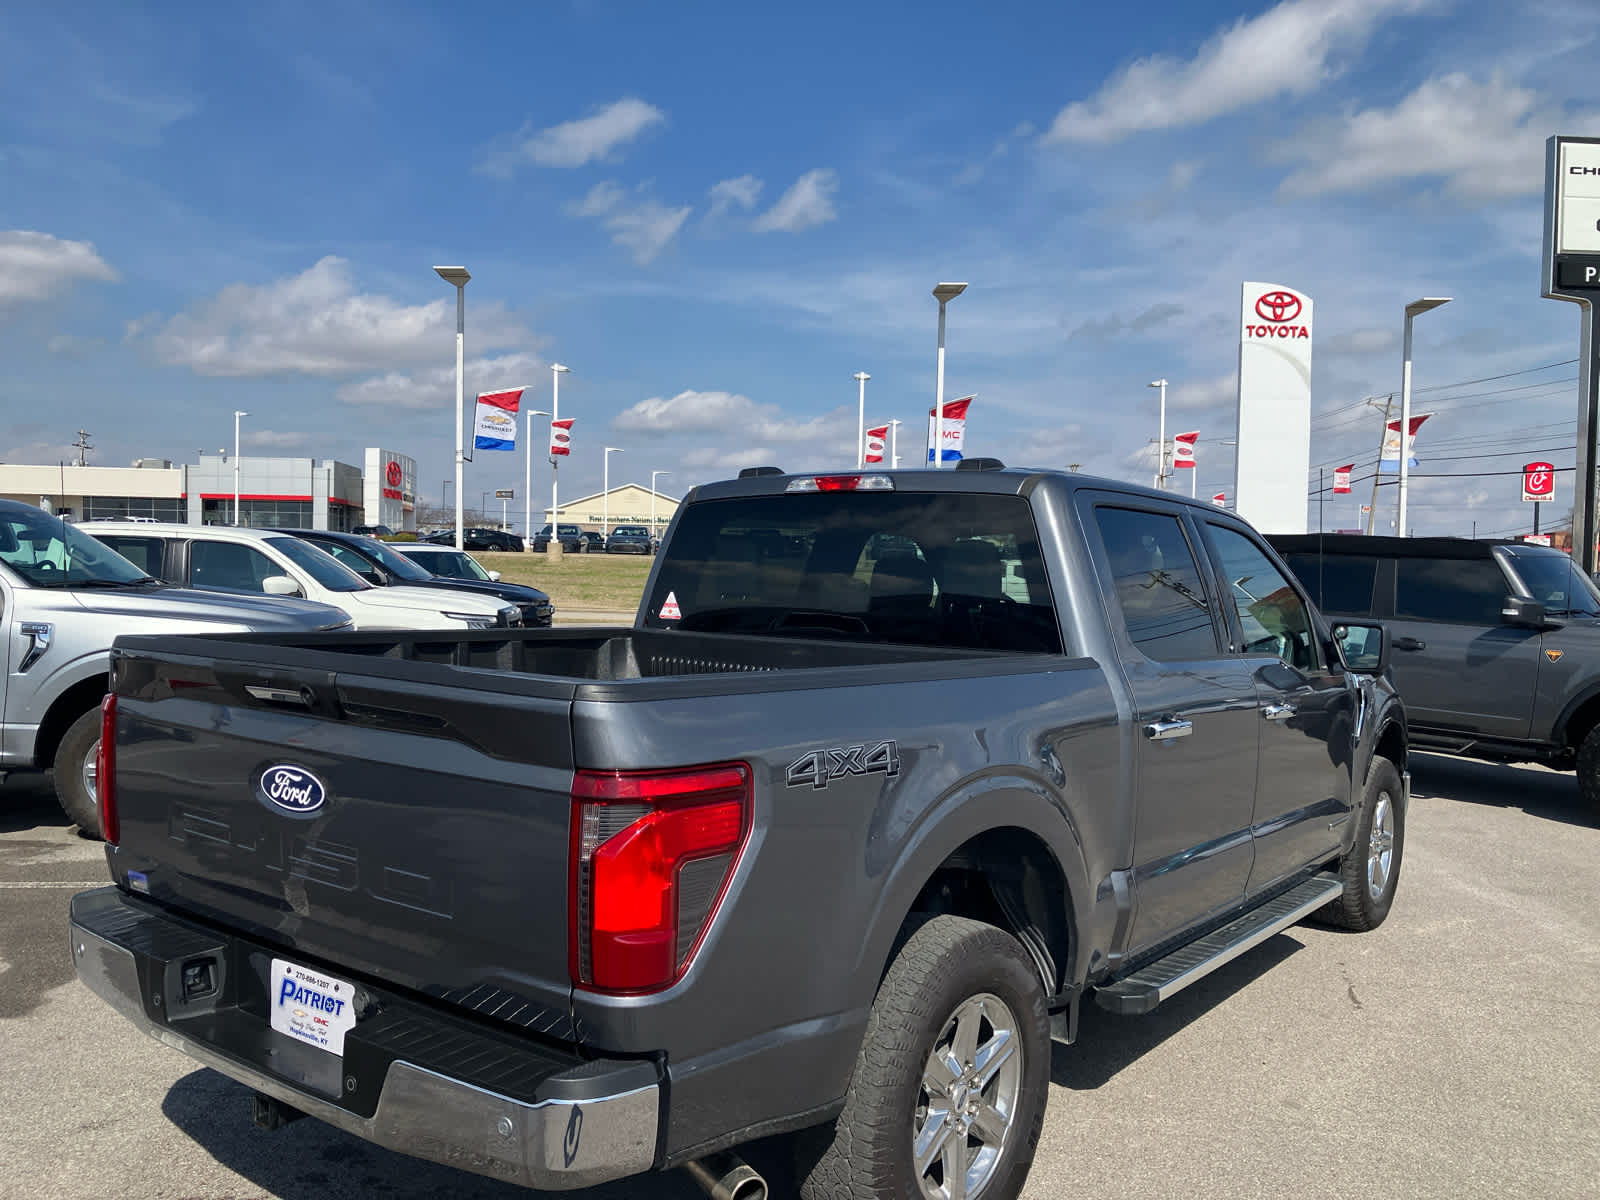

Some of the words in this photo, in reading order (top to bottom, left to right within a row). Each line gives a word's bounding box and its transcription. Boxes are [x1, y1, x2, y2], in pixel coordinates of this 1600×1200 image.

[1246, 325, 1309, 339] TOYOTA
[935, 430, 961, 440] MC
[271, 770, 312, 805] Ford
[313, 1016, 329, 1027] GMC
